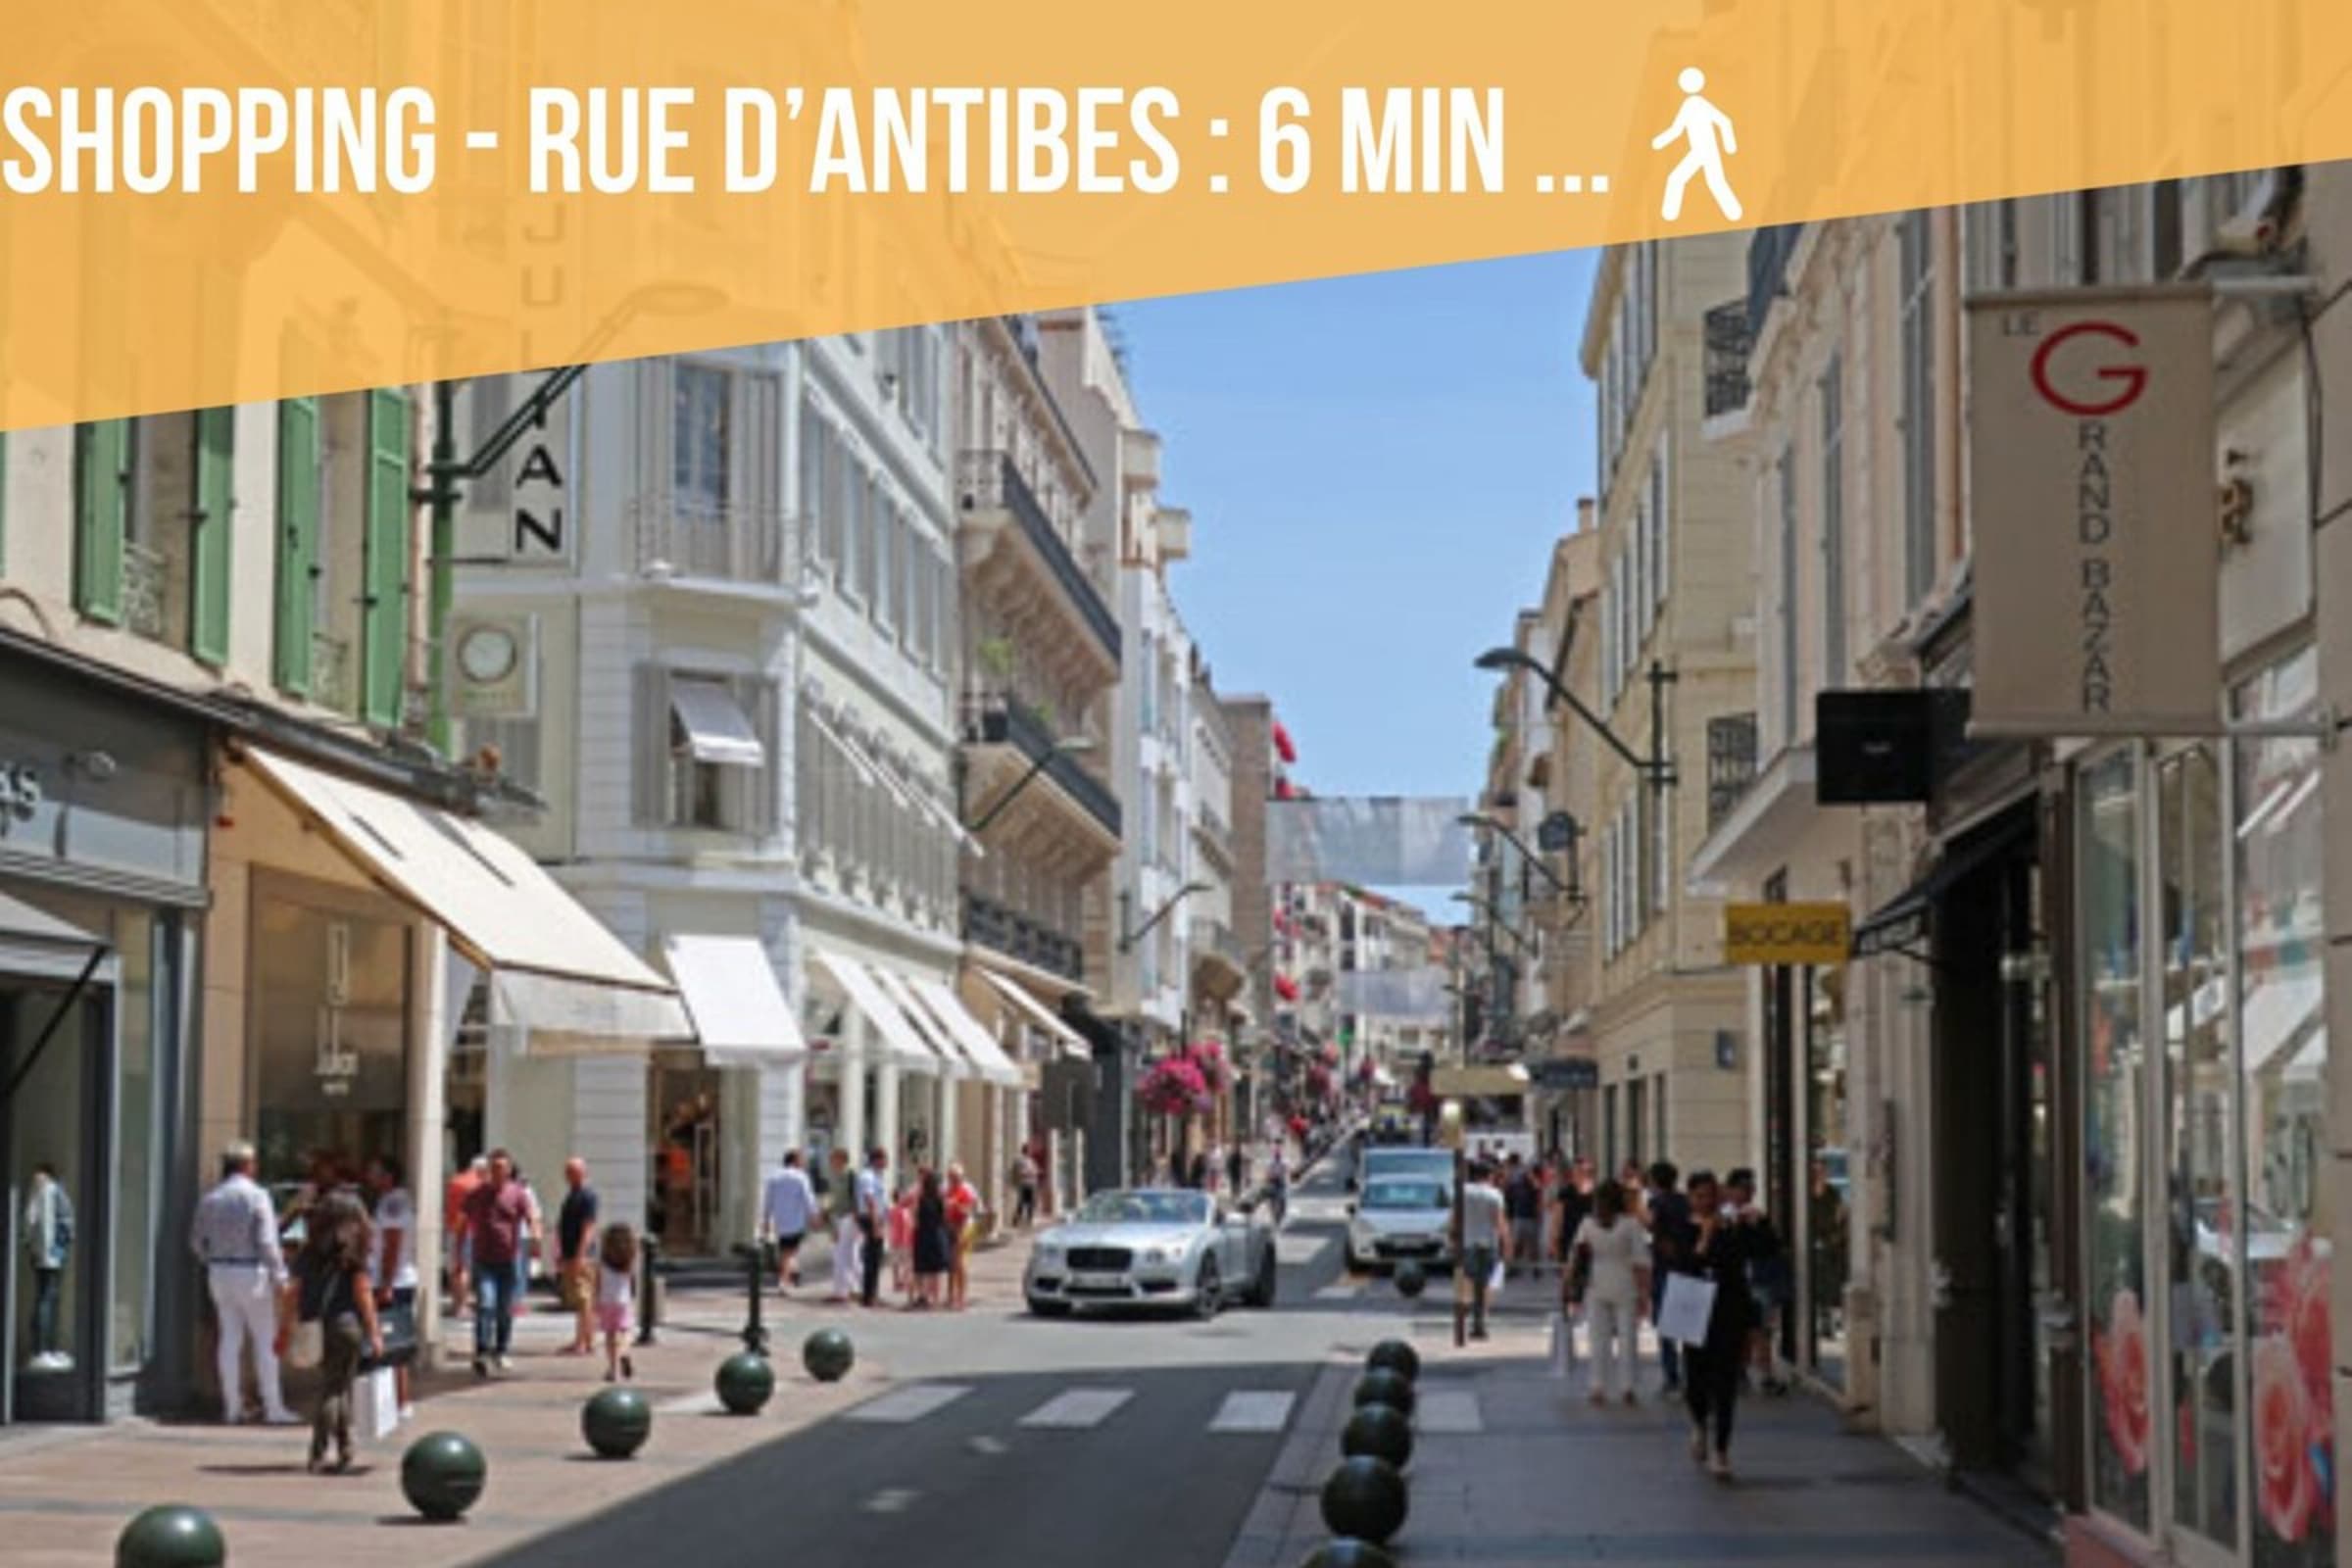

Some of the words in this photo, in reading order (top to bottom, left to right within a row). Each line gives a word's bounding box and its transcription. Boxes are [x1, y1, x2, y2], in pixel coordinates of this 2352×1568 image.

[2003, 313, 2039, 336] LE
[2080, 559, 2109, 713] BAZAR
[1729, 919, 1843, 947] BOCAGE
